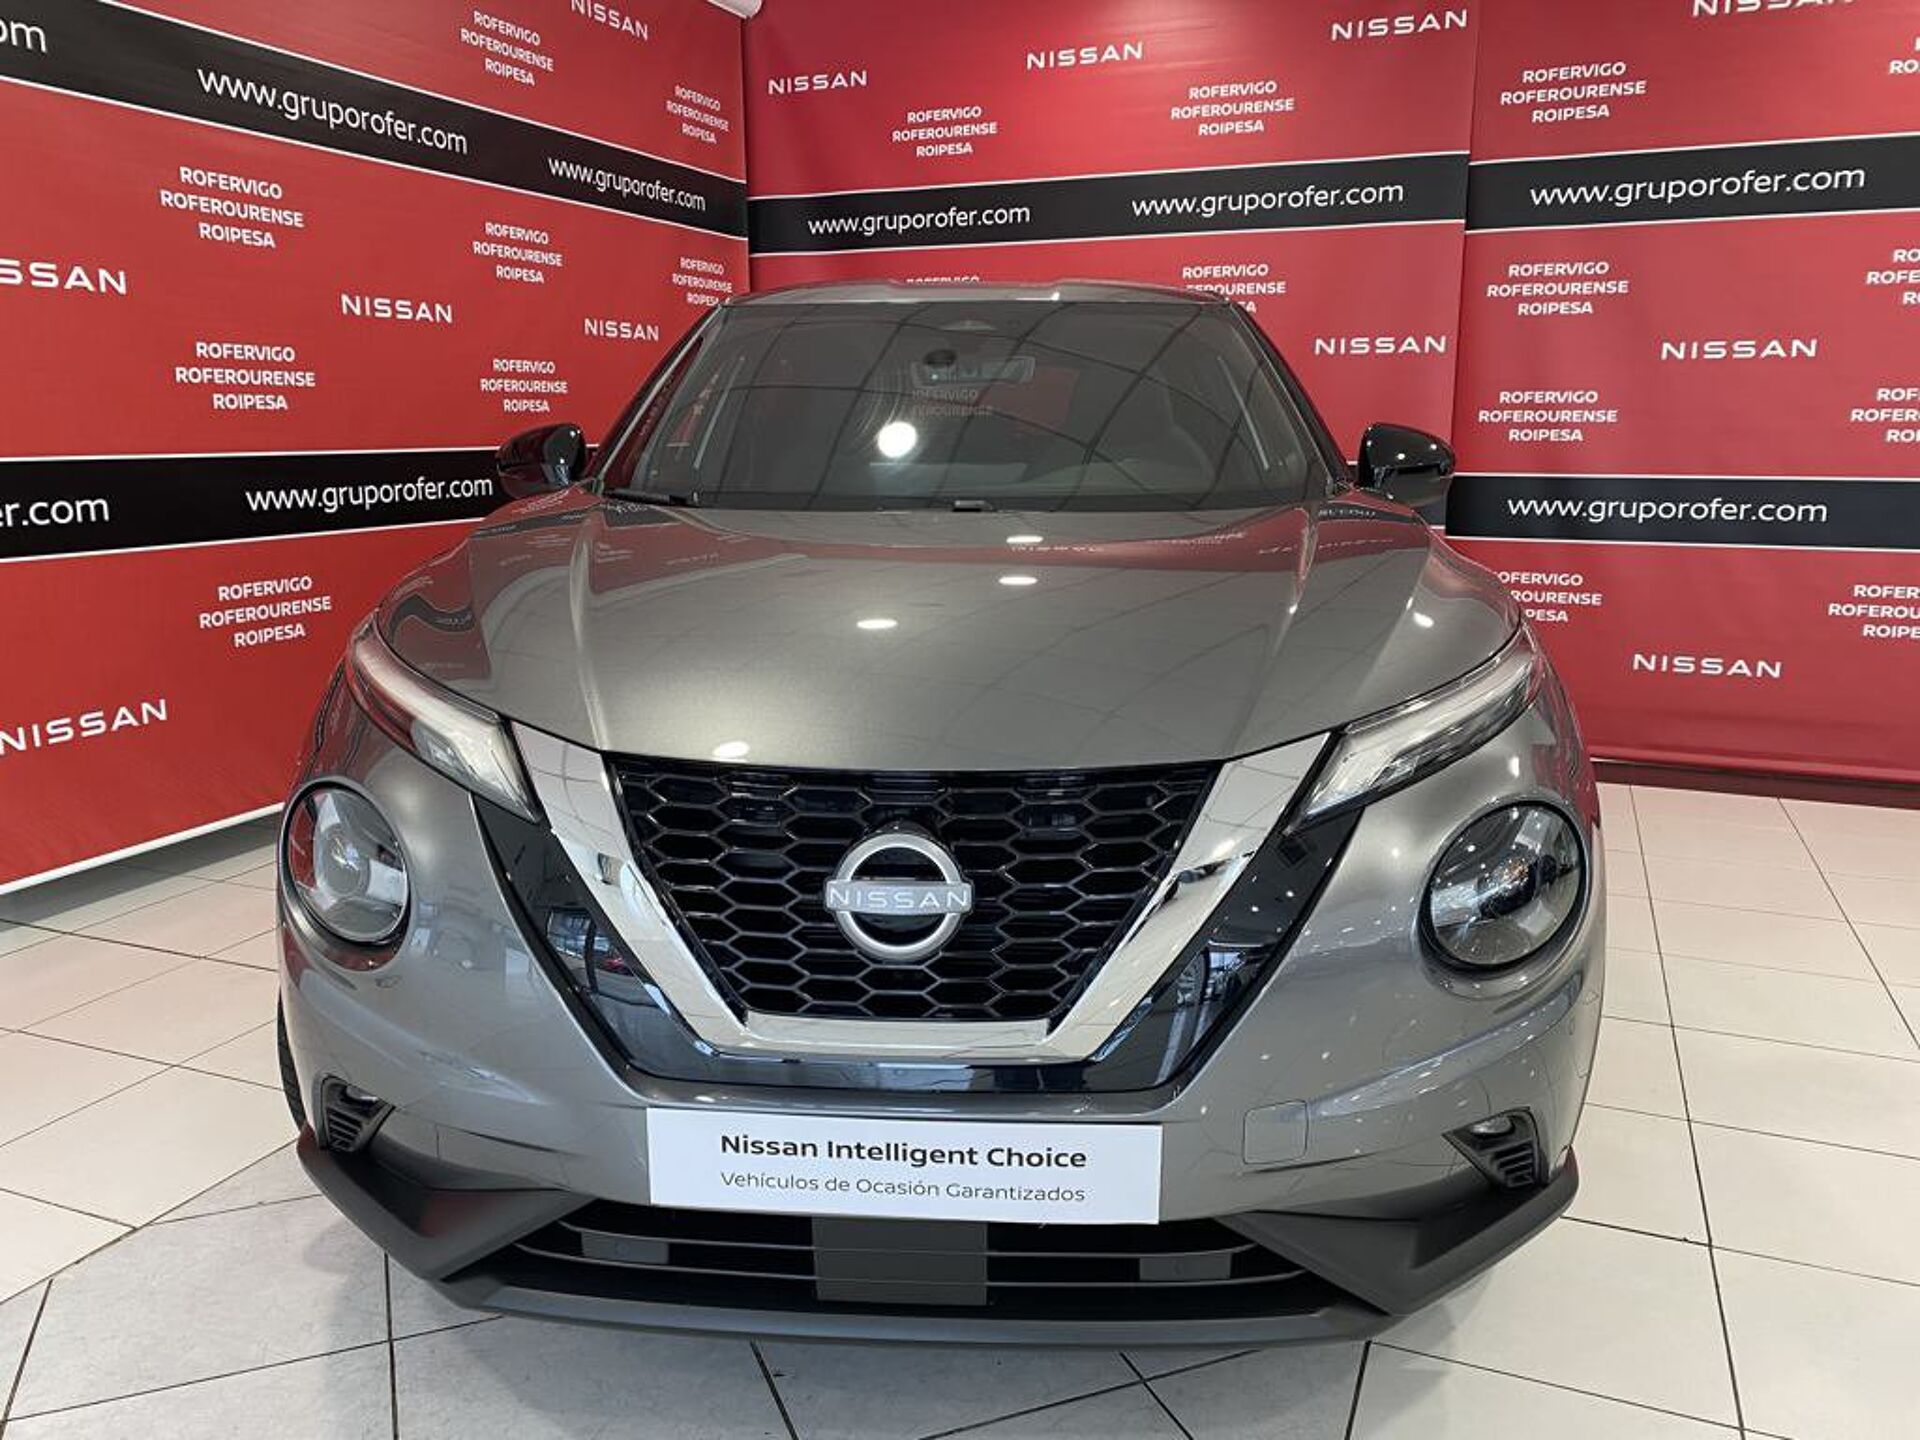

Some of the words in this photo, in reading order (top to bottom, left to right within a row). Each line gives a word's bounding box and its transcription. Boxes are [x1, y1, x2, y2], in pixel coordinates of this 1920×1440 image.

[571, 0, 648, 40] NISSAN
[1693, 0, 1856, 17] NIS
[473, 11, 541, 46] ROFERVIGO
[1331, 10, 1467, 41] NISSAN
[460, 28, 554, 72] ROFEROURENSE
[1027, 42, 1143, 70] NISSAN
[485, 58, 535, 86] ROIPESA
[768, 71, 867, 95] NISSAN
[1522, 61, 1627, 83] ROFERVIGO
[1189, 80, 1277, 100] ROFERVIGO
[1500, 80, 1647, 105] ROFEROURENSE
[197, 68, 468, 156] www.gruporofer.com
[907, 106, 982, 123] ROFERVIGO
[1171, 98, 1294, 120] ROFEROURENSE
[1531, 104, 1610, 123] ROIPESA
[892, 121, 997, 142] ROFEROURENSE
[1199, 120, 1264, 136] ROIPESA
[916, 142, 973, 157] ROIPESA
[180, 166, 283, 199] ROFERVIGO
[548, 158, 706, 211] www.gruporofer.com
[1531, 168, 1865, 207] www.gruporofer.com
[160, 190, 304, 227] ROFEROURENSE
[1132, 184, 1404, 218] www.gruporofer.com
[808, 205, 1031, 236] www.gruporofer.com
[199, 223, 276, 248] ROIPESA
[485, 222, 549, 245] ROFERVIGO
[473, 241, 562, 267] ROFEROURENSE
[496, 265, 544, 284] ROIPESA
[1182, 264, 1269, 279] ROFERVIGO
[1508, 261, 1609, 278] ROFERVIGO
[1487, 280, 1629, 298] ROFEROURENSE
[341, 294, 453, 323] NISSAN
[1517, 301, 1593, 316] ROIPESA
[584, 318, 659, 341] NISSAN
[196, 342, 296, 363] ROFERVIGO
[1315, 335, 1446, 355] NISSAN
[1661, 339, 1817, 360] NISSAN
[175, 366, 316, 387] ROFEROURENSE
[493, 358, 556, 374] ROFERVIGO
[480, 378, 569, 394] ROFEROURENSE
[1499, 390, 1599, 404] ROFERVIGO
[213, 394, 288, 411] ROIPESA
[503, 398, 550, 412] ROIPESA
[1478, 409, 1618, 423] ROFEROURENSE
[1508, 428, 1583, 442] ROIPESA
[246, 477, 493, 513] www.gruporofer.com
[0, 498, 110, 527] r.com
[1508, 497, 1828, 524] www.gruporofer.com
[218, 576, 312, 601] ROFERVIGO
[1498, 571, 1584, 586] OFERVIGO
[199, 596, 332, 629] ROFEROURENSE
[233, 623, 306, 648] ROIPESA
[1633, 653, 1782, 678] NISSAN
[0, 699, 168, 756] NISSAN
[829, 886, 968, 909] NISSAN
[721, 1134, 818, 1158] Nissan
[827, 1141, 979, 1168] Intelligent
[986, 1147, 1087, 1169] Choice
[721, 1171, 819, 1192] Vehículos
[825, 1177, 851, 1193] de
[856, 1178, 940, 1198] Ocasión
[946, 1183, 1086, 1202] Garantizados
